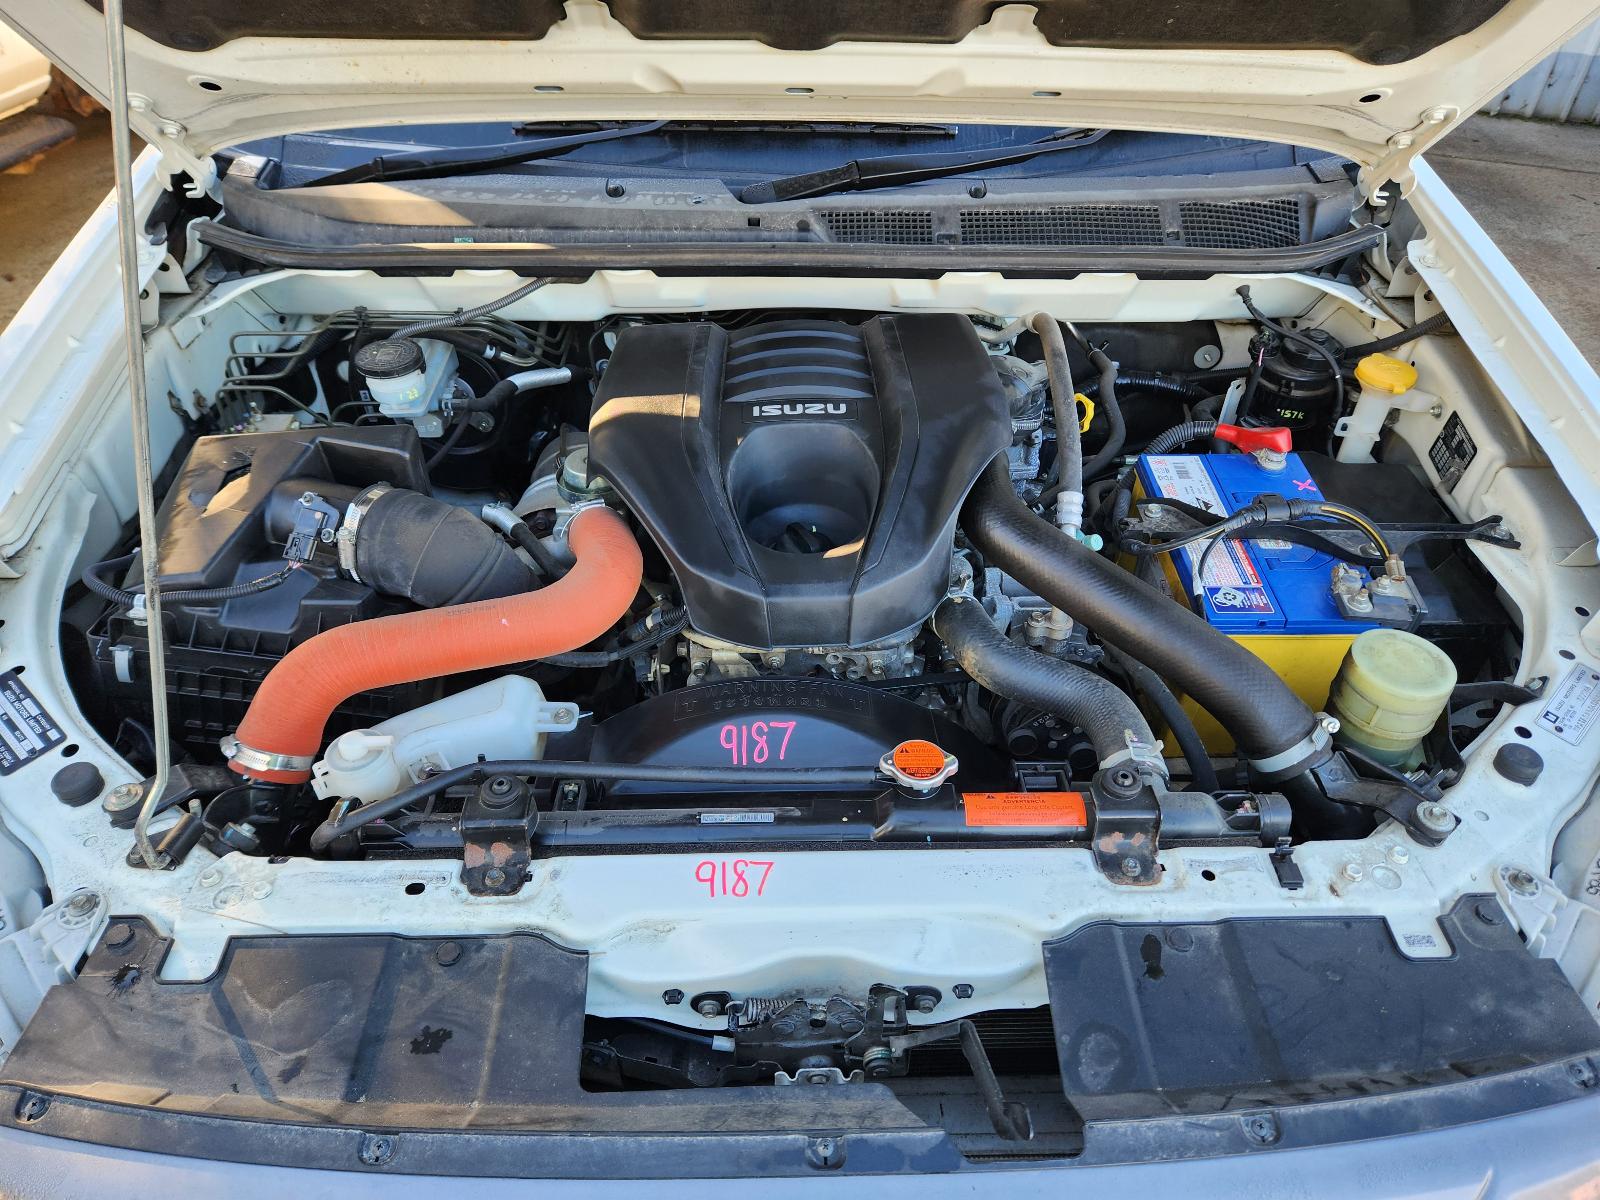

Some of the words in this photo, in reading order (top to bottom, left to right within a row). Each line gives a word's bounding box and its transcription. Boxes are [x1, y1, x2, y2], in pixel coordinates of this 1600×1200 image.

[752, 403, 847, 417] ISUZU
[26, 716, 41, 733] LIMITED
[720, 721, 797, 766] 9187
[695, 858, 775, 897] 9187
